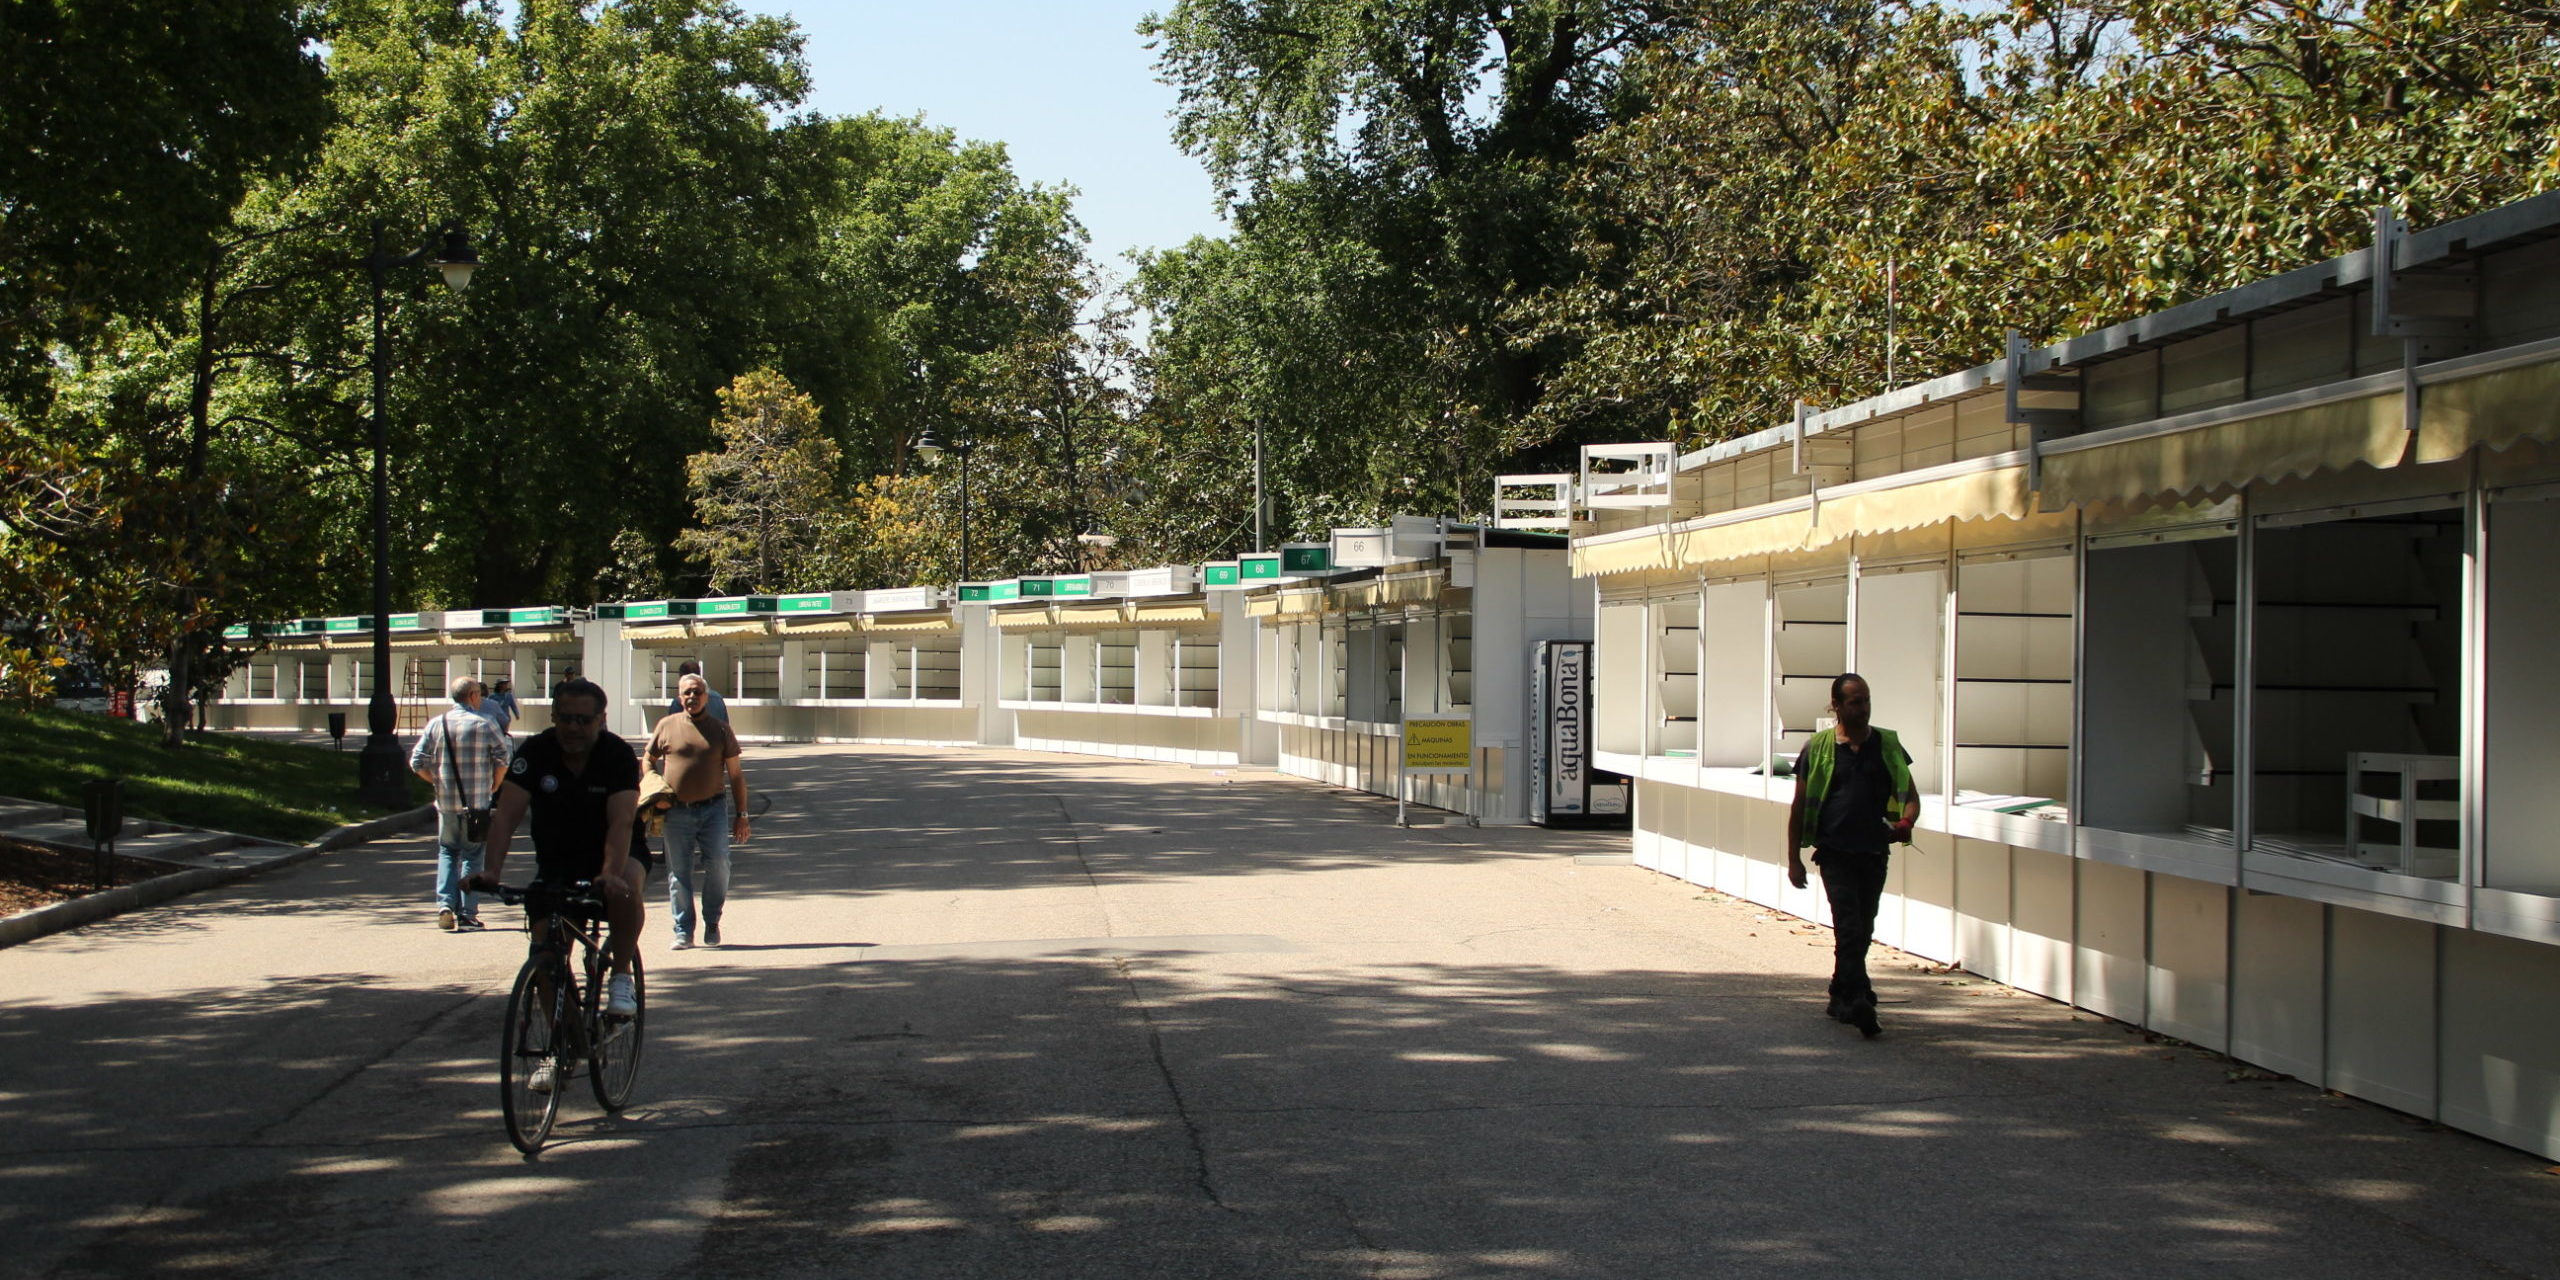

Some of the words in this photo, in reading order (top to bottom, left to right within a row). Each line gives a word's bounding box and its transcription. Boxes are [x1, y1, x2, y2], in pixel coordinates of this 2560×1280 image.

[1353, 541, 1364, 552] 66
[1301, 554, 1312, 565] 67
[1255, 564, 1265, 574] 68
[1219, 570, 1228, 580] 69
[970, 589, 979, 597] 72
[1032, 584, 1041, 592] 71
[1556, 661, 1584, 781] aquaBona
